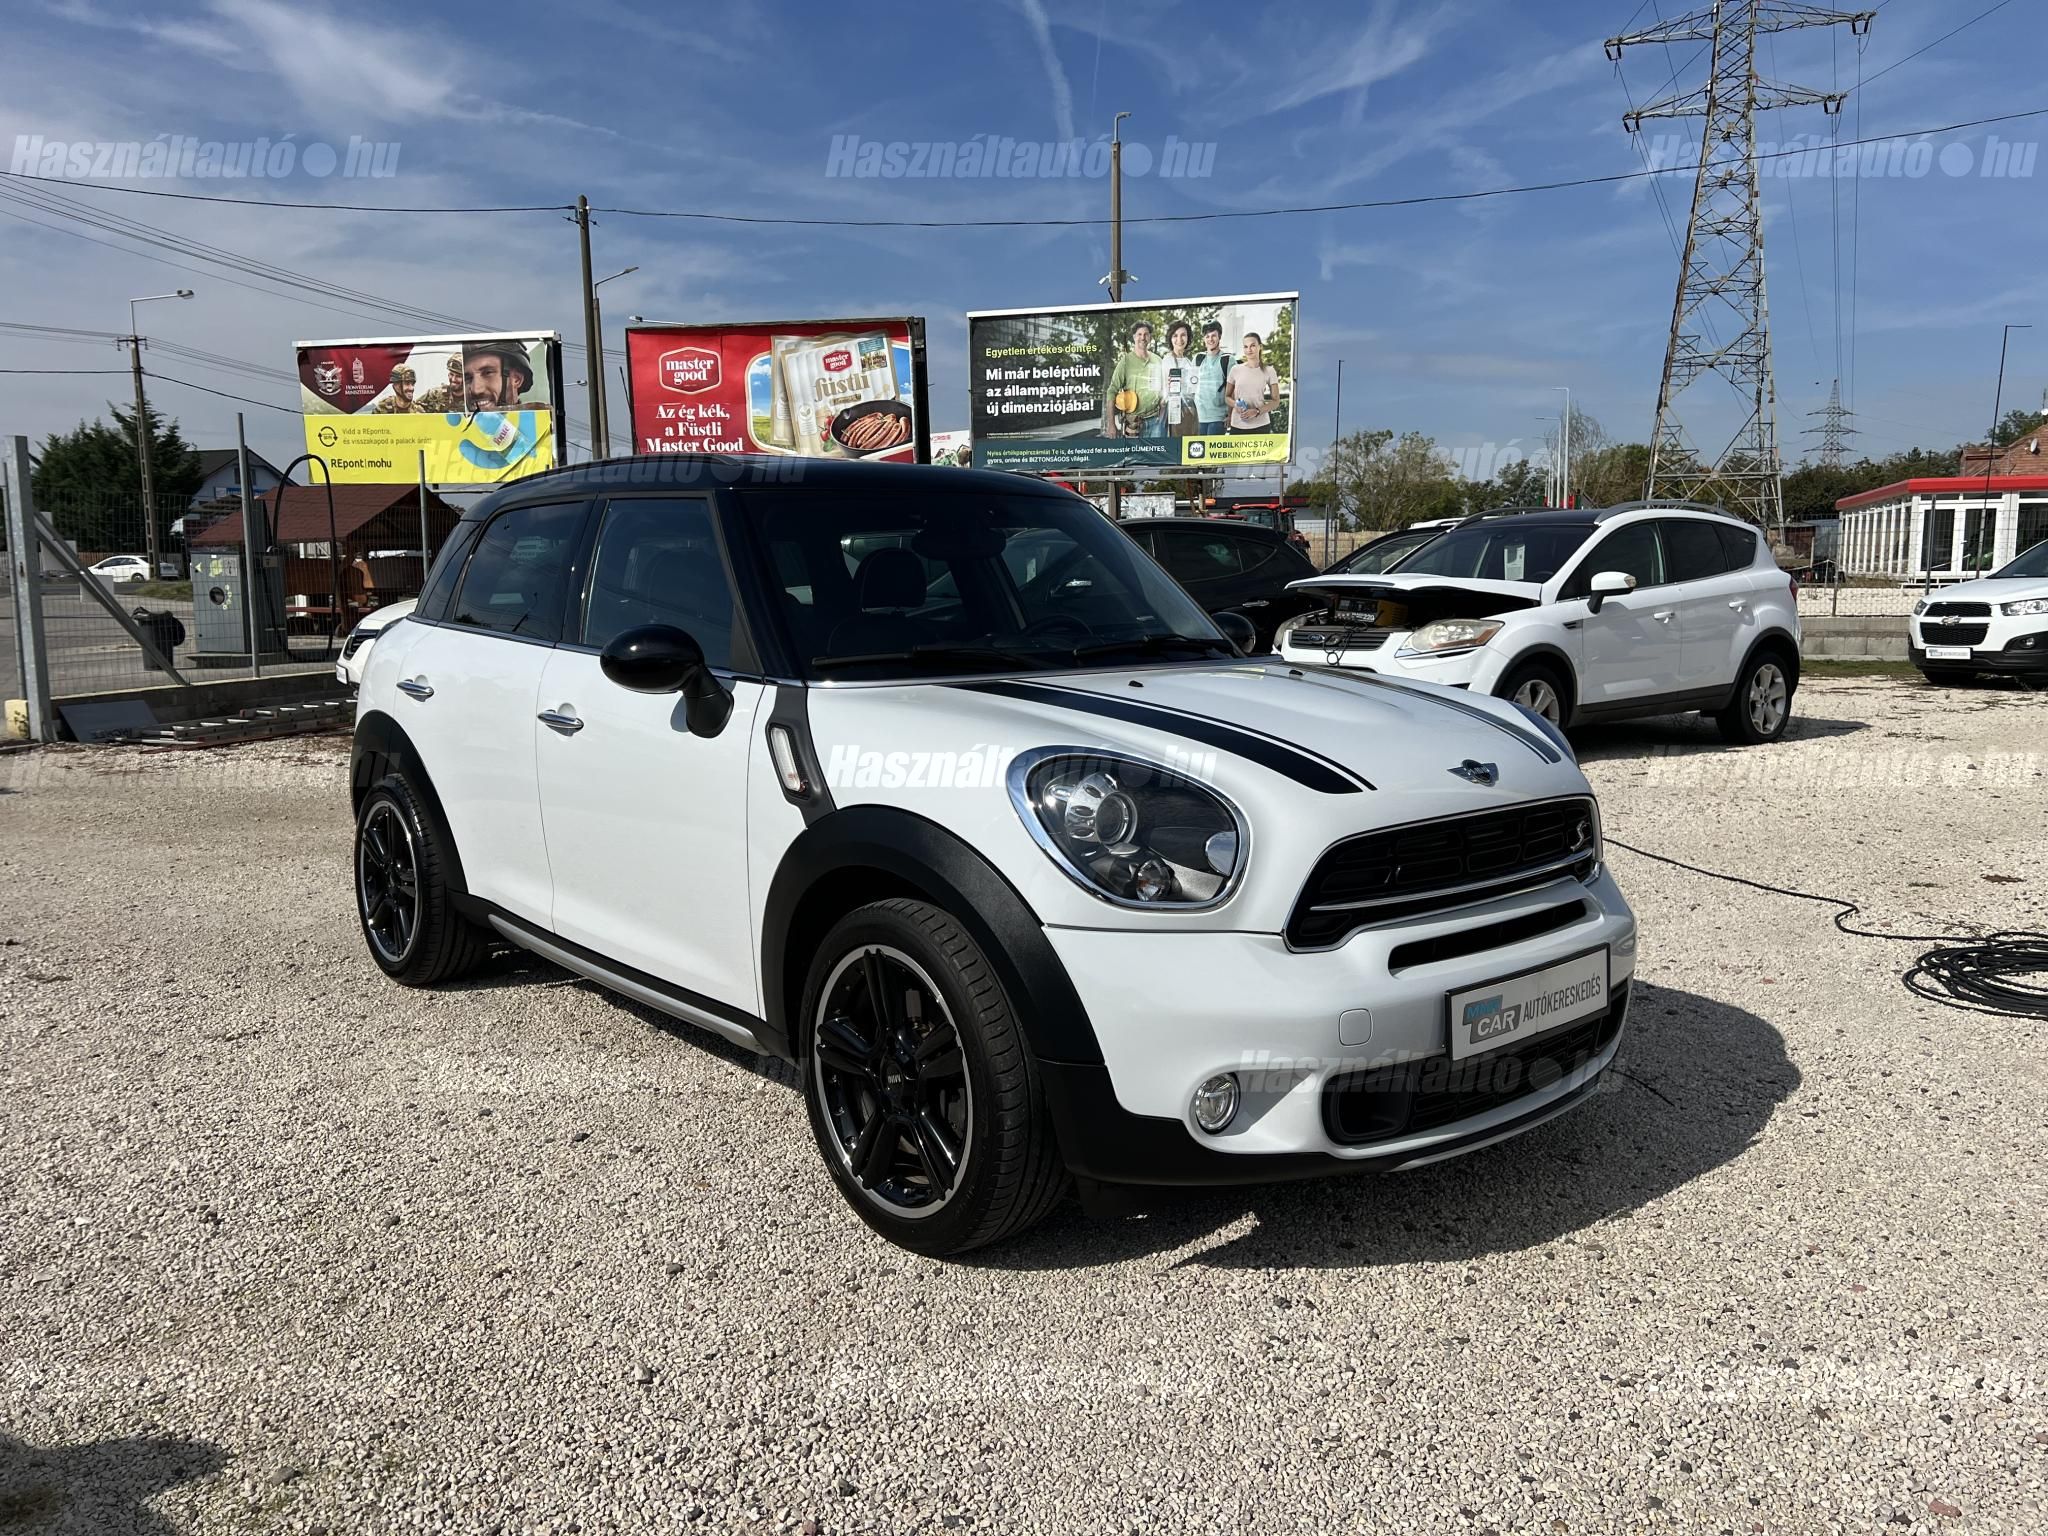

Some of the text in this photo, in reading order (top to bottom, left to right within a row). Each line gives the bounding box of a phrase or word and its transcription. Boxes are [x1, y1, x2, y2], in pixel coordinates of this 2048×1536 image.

[985, 343, 1097, 358] Egyetlen értékes döntés
[666, 357, 714, 371] master
[986, 364, 1101, 380] Mi már beléptünk
[674, 368, 708, 385] good
[815, 372, 870, 402] füstli
[986, 387, 1002, 397] az
[656, 403, 730, 422] Az ég kék,
[986, 399, 1094, 416] új dimenziójába!
[665, 421, 722, 437] a Füstli
[645, 437, 744, 453] Master Good
[1478, 972, 1600, 1036] CAR AUTÓKERESKEDÉS
